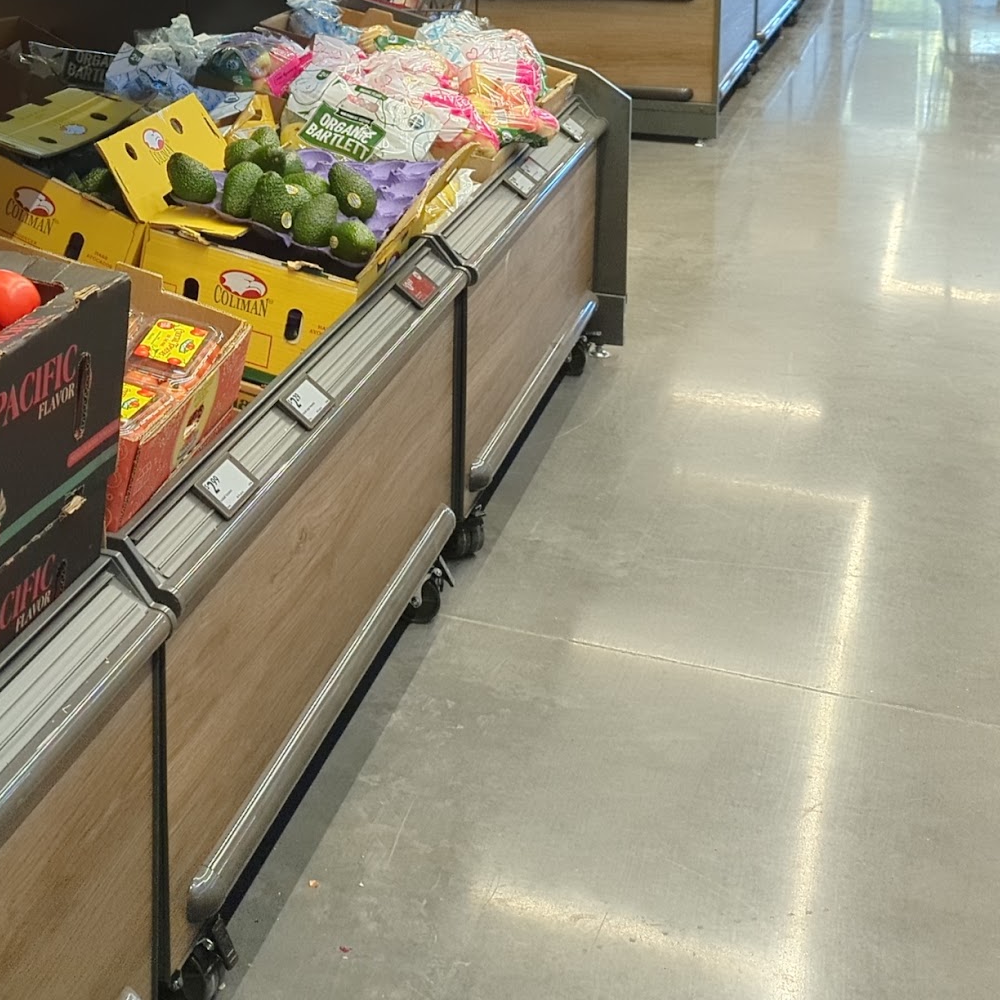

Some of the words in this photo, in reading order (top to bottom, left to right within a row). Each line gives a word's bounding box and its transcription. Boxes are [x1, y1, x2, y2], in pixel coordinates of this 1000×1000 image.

[305, 122, 370, 160] BARTLETT
[319, 113, 373, 144] ORGANIC
[5, 198, 55, 236] COLIMAN
[213, 283, 270, 318] COLIMAN
[37, 382, 75, 421] FLAVOR
[15, 590, 52, 634] FLAVOR
